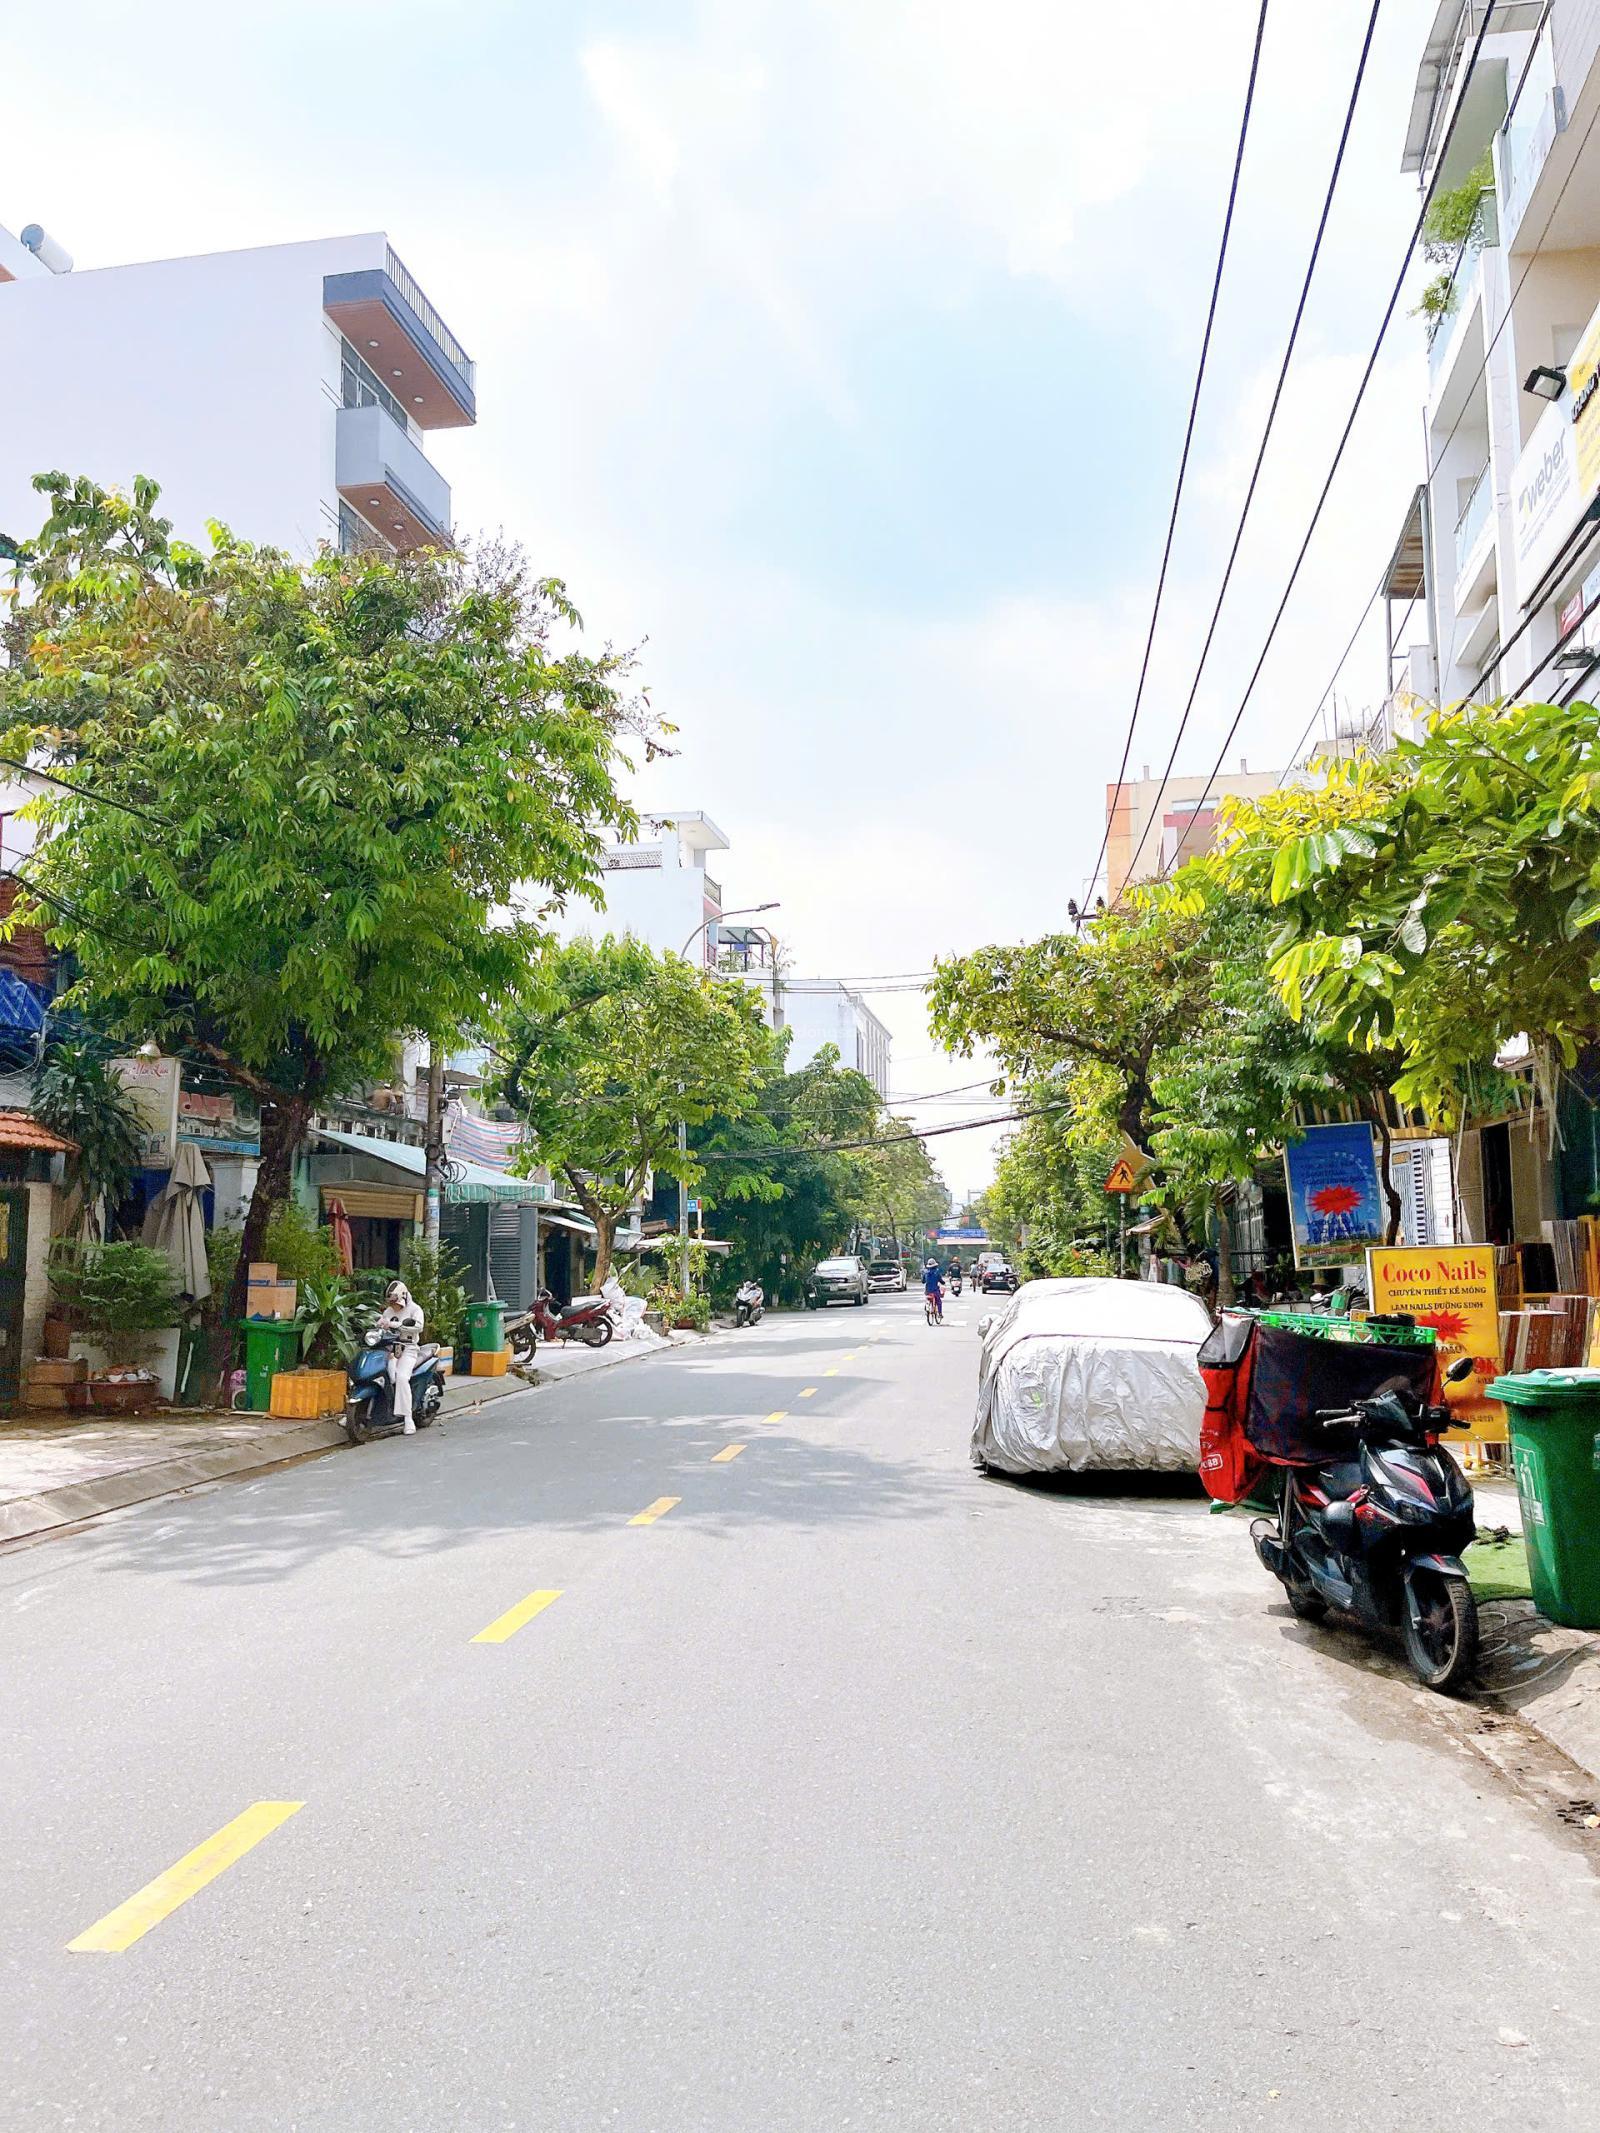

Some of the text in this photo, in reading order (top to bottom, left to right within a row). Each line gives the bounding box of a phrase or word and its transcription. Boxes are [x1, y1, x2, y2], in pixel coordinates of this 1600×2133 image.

[1527, 428, 1566, 513] weber
[1383, 1260, 1487, 1282] Coco Nails
[1388, 1285, 1486, 1297] CHUYÊN THIẾT KẾ MÓNG
